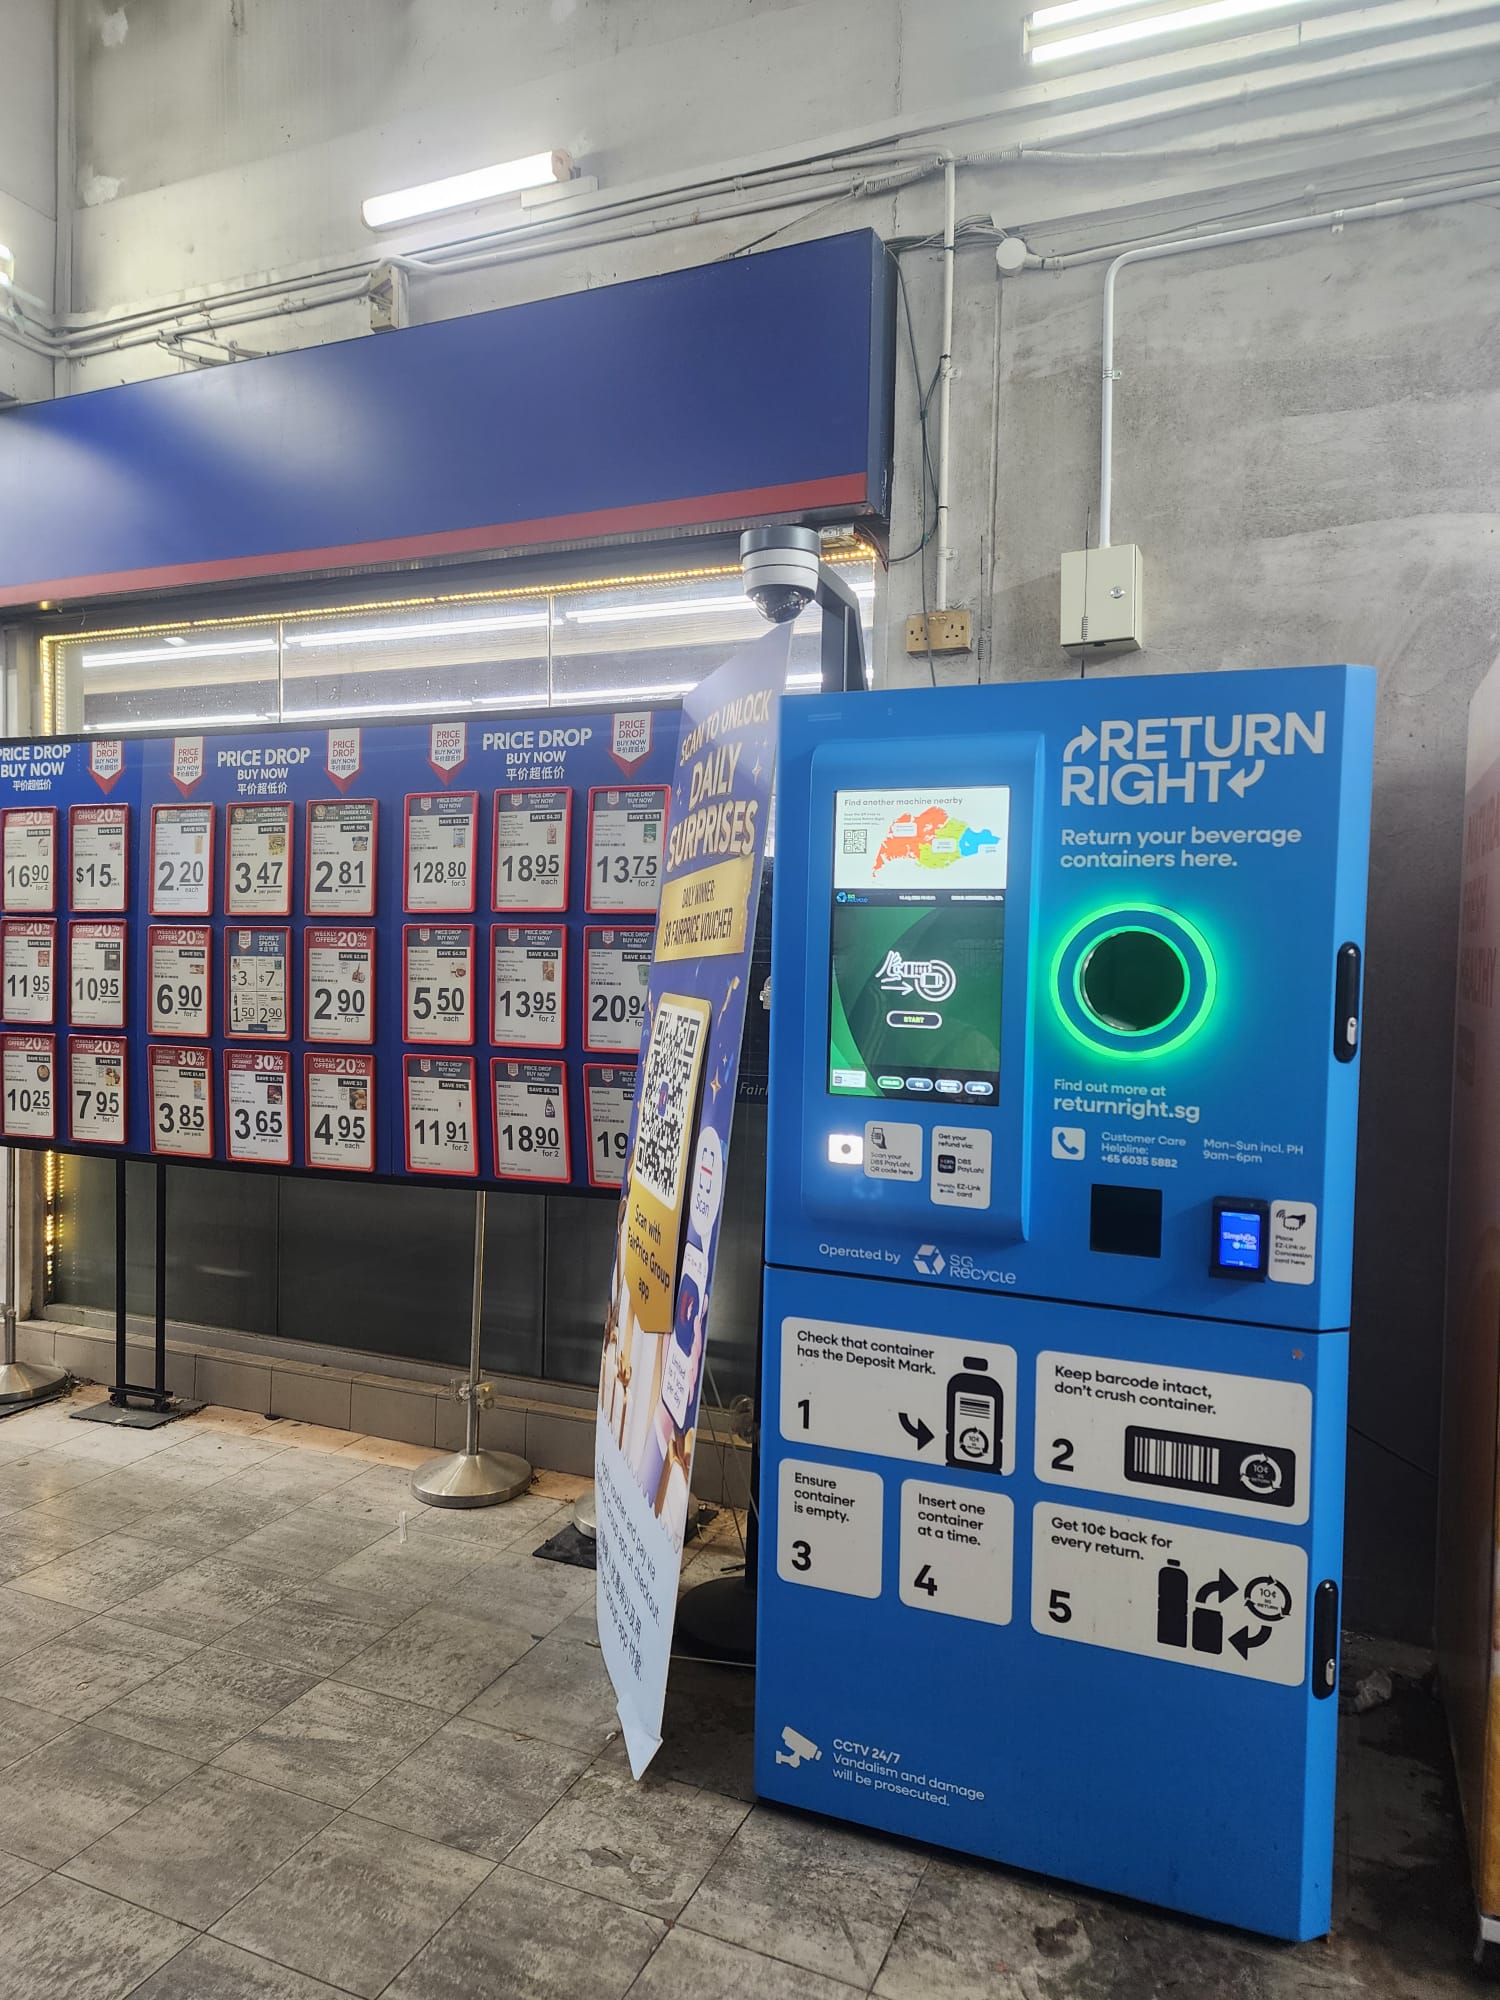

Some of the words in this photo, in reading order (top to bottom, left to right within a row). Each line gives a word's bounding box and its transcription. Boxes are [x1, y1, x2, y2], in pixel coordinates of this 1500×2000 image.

[482, 731, 534, 750] PRICE
[538, 728, 592, 747] DROP
[680, 722, 704, 766] SCAN
[706, 710, 720, 744] TO
[721, 689, 772, 734] UNLOCK
[1100, 710, 1326, 762] RETURN
[34, 744, 72, 760] DROP
[217, 750, 261, 768] PRICE
[265, 747, 311, 765] DROP
[506, 751, 534, 766] BUY
[535, 750, 566, 764] NOW
[1, 763, 26, 778] BUY
[30, 762, 64, 776] NOW
[237, 768, 259, 780] BUY
[260, 768, 288, 780] NOW
[506, 766, 566, 782] 平价超低价
[689, 742, 742, 810] DAILY
[1061, 760, 1232, 806] RIGHT
[237, 782, 288, 796] 平价超低价
[863, 798, 894, 806] another
[933, 797, 964, 806] nearby
[666, 800, 758, 873] SURPRISES
[1061, 828, 1132, 846] Return
[1137, 832, 1186, 848] your
[1191, 826, 1302, 848] beverage
[502, 854, 560, 882] 18.95
[597, 855, 658, 884] 13.75
[1060, 850, 1176, 868] containers
[1180, 850, 1238, 868] here.
[8, 864, 48, 888] 16.90
[76, 864, 112, 888] $15
[158, 860, 204, 892] 2.20
[234, 862, 284, 894] 3.47
[314, 860, 364, 893] 2.81
[413, 861, 466, 884] 128.80
[700, 907, 733, 941] VOUCHER
[7, 974, 50, 998] 11.95
[74, 977, 119, 1002] 10.95
[156, 983, 202, 1016] 6.90
[314, 988, 365, 1020] 2.90
[413, 986, 464, 1020] 5.50
[500, 990, 556, 1018] 13.95
[904, 1016, 925, 1024] START
[7, 1088, 50, 1112] 10.25
[1054, 1078, 1082, 1092] Find
[1085, 1082, 1108, 1094] out
[1110, 1084, 1148, 1096] more
[1150, 1086, 1166, 1097] at
[76, 1090, 120, 1120] 7.95
[158, 1102, 204, 1134] 3.85
[1054, 1096, 1200, 1124] returnright.sg
[234, 1108, 282, 1140] 3.65
[314, 1114, 366, 1146] 4.95
[414, 1119, 468, 1146] 11.91
[938, 1132, 950, 1140] Get
[952, 1134, 967, 1142] your
[502, 1124, 560, 1154] 18.90
[938, 1140, 960, 1149] refund
[1102, 1132, 1156, 1146] Customer
[1158, 1135, 1186, 1148] Care
[1102, 1143, 1148, 1156] Helpline:
[1260, 1142, 1284, 1154] incl.
[1286, 1144, 1304, 1155] PH
[870, 1151, 886, 1160] Scan
[888, 1152, 902, 1161] your
[1102, 1154, 1120, 1164] +65
[1122, 1155, 1149, 1166] 6035
[1150, 1157, 1178, 1168] 5882
[898, 1168, 914, 1176] here
[958, 1166, 984, 1175] PayLah!
[957, 1183, 981, 1192] EZ-Link
[957, 1190, 972, 1198] card
[695, 1192, 710, 1218] Scan
[634, 1203, 648, 1233] Scan
[648, 1217, 662, 1246] with
[628, 1228, 649, 1267] FairPrice
[650, 1253, 670, 1293] Group
[818, 1243, 882, 1262] Operated
[884, 1250, 901, 1264] by
[950, 1254, 974, 1268] SG
[638, 1276, 650, 1304] app
[797, 1329, 838, 1346] Check
[841, 1335, 869, 1350] that
[870, 1339, 936, 1360] container
[797, 1344, 820, 1358] has
[822, 1347, 844, 1362] the
[846, 1350, 896, 1370] Deposit
[898, 1358, 936, 1376] Mark.
[1054, 1364, 1092, 1383] Keep
[1095, 1368, 1160, 1390] barcode
[1162, 1377, 1212, 1400] intact,
[1054, 1381, 1092, 1398] don't
[1095, 1386, 1136, 1404] crush
[1138, 1392, 1217, 1415] container.
[798, 1399, 810, 1430] 1
[1050, 1438, 1075, 1472] 2
[794, 1472, 837, 1490] Ensure
[794, 1487, 856, 1508] container
[918, 1493, 957, 1512] Insert
[958, 1501, 986, 1516] one
[794, 1500, 804, 1514] is
[806, 1504, 850, 1524] empty.
[918, 1509, 984, 1531] container
[918, 1524, 932, 1536] at
[934, 1529, 944, 1539] a
[946, 1528, 982, 1546] time.
[1051, 1516, 1079, 1533] Get
[1082, 1522, 1106, 1537] 10¢
[1110, 1525, 1148, 1546] back
[1150, 1532, 1172, 1550] for
[791, 1540, 812, 1572] 3
[1051, 1534, 1094, 1554] every
[1096, 1543, 1144, 1562] return.
[913, 1564, 938, 1597] 4
[1048, 1588, 1072, 1624] 5
[832, 1738, 870, 1757] CCTV
[872, 1748, 900, 1764] 24/7
[832, 1768, 852, 1782] will
[855, 1773, 872, 1786] be
[874, 1777, 950, 1806] prosecuted.
[833, 1752, 898, 1778] Vandalism
[900, 1771, 926, 1786] and
[928, 1777, 984, 1801] damage
